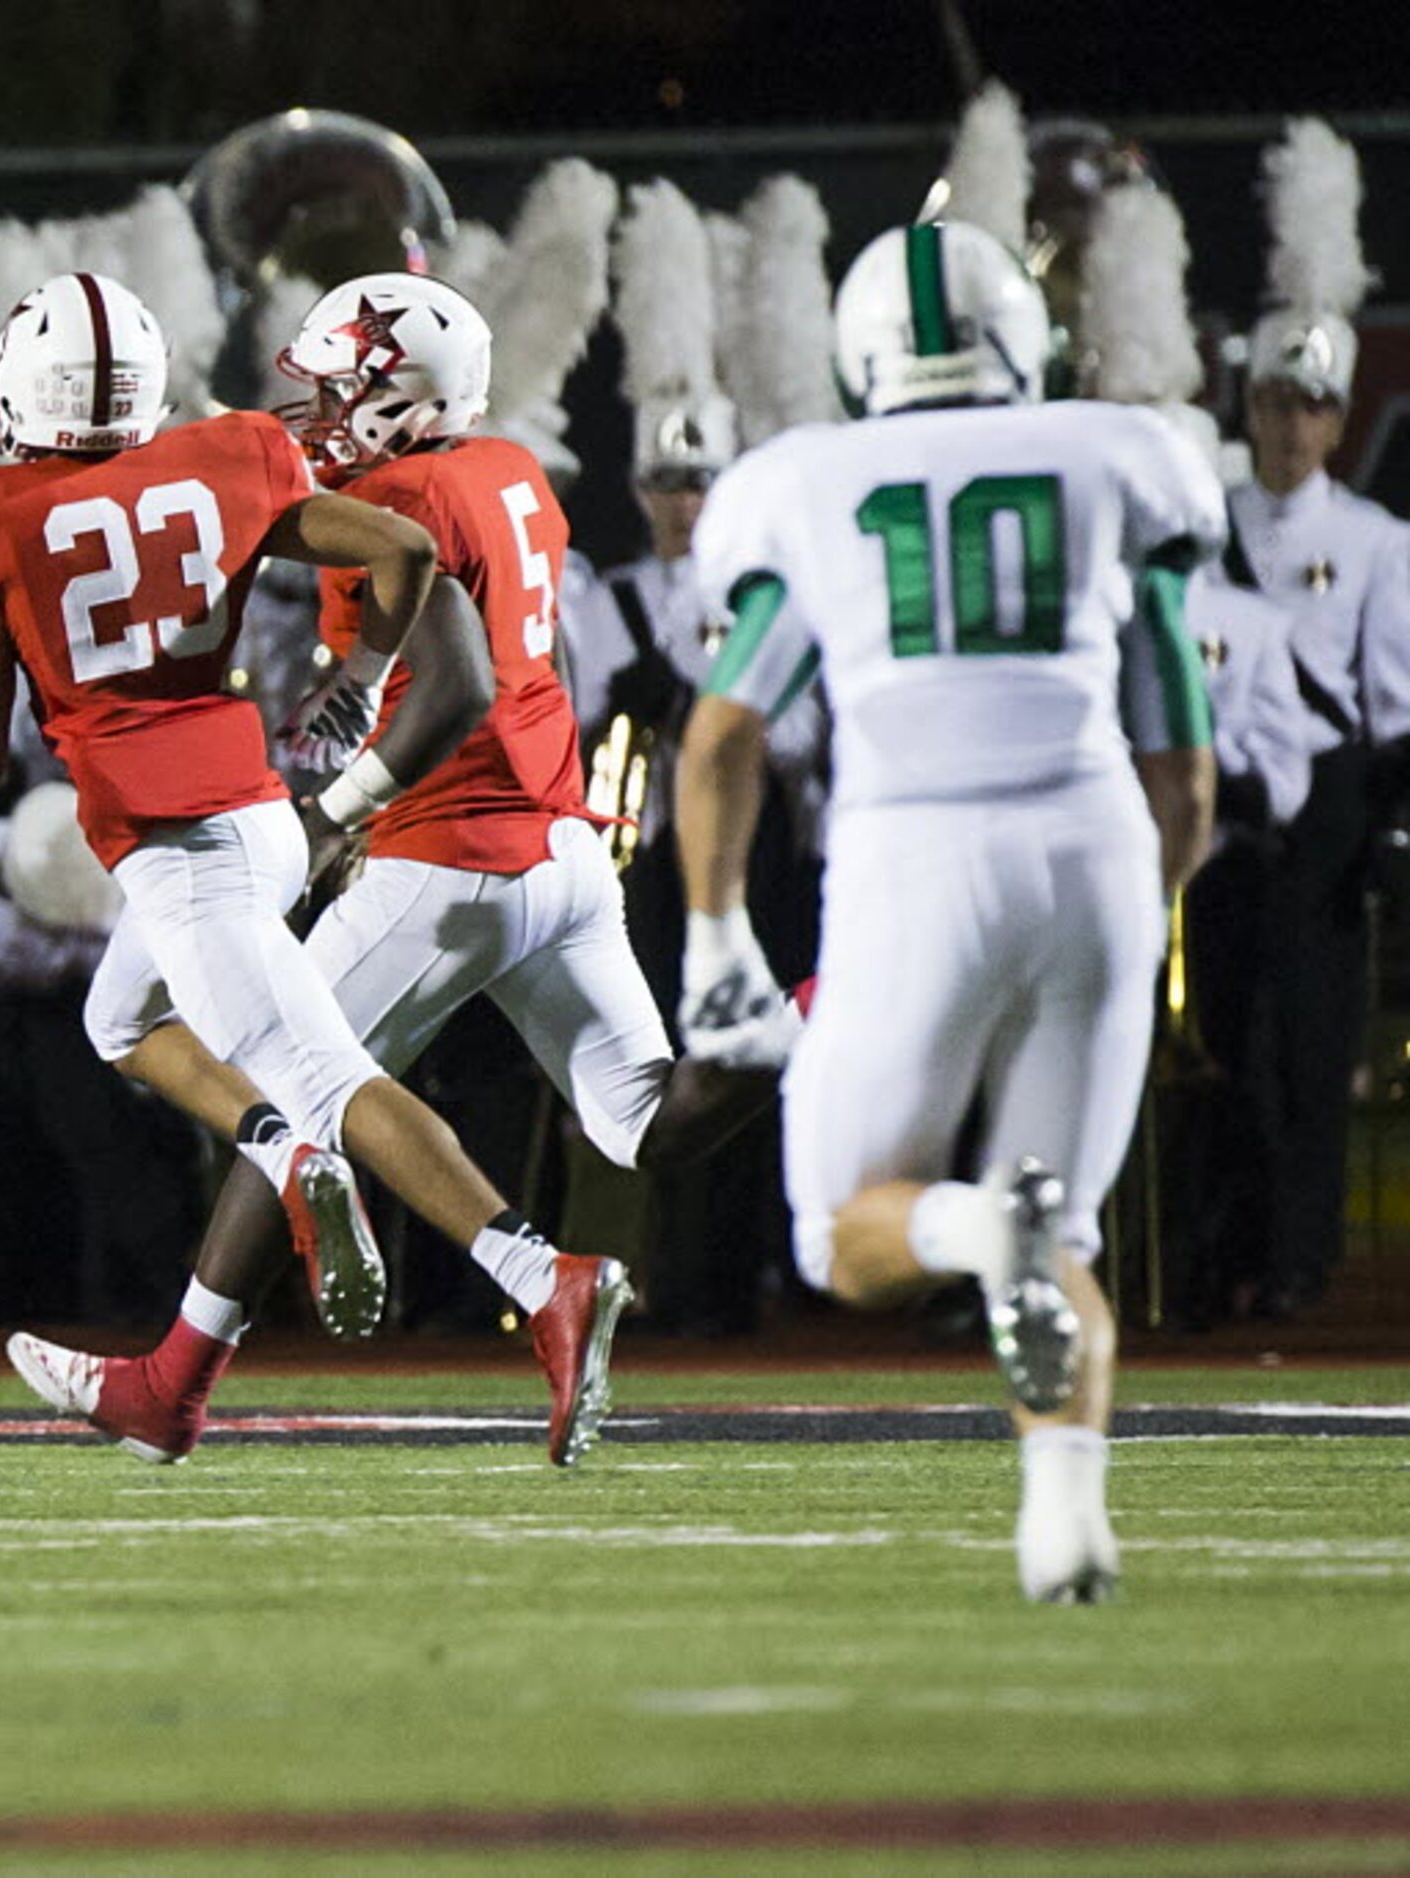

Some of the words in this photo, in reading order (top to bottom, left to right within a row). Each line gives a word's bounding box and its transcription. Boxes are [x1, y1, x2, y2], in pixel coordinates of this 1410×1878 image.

[56, 430, 141, 447] Riddell
[44, 478, 229, 683] 23
[500, 480, 555, 660] 5
[856, 473, 1065, 657] 10
